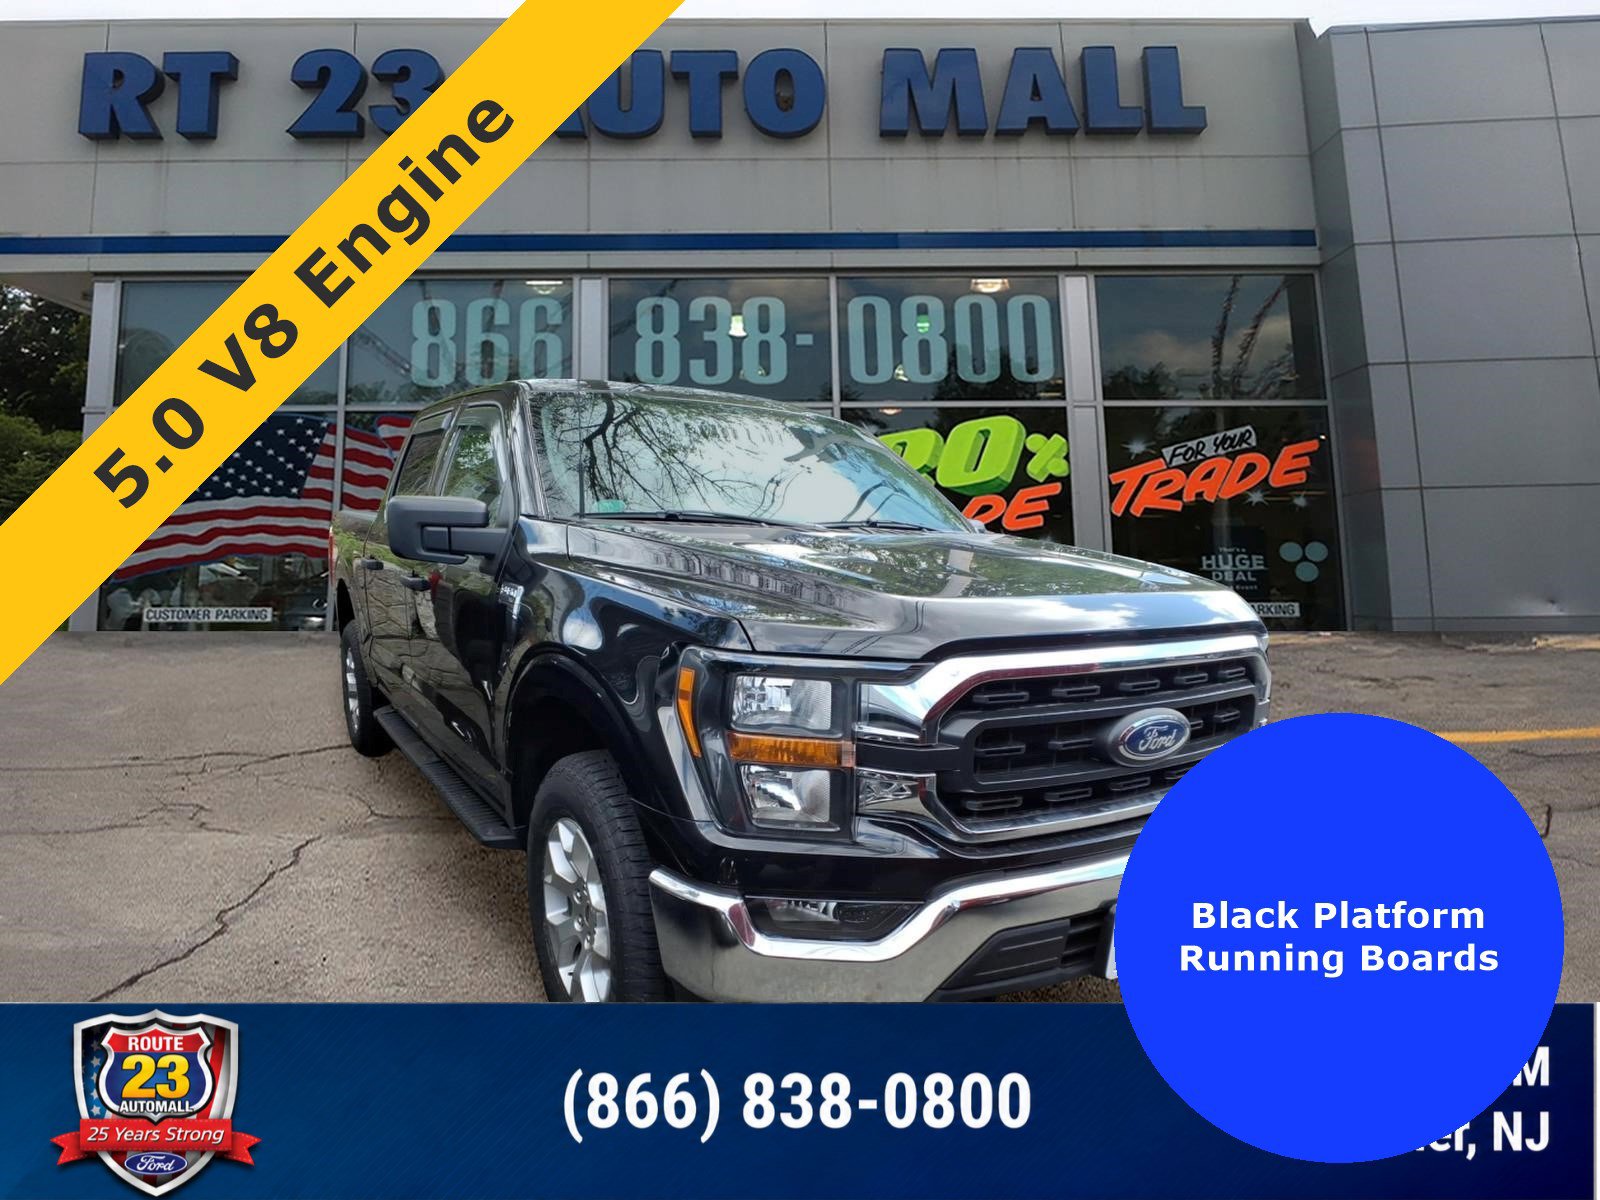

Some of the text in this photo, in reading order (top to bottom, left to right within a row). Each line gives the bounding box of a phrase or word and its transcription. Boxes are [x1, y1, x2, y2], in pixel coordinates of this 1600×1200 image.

[78, 46, 1208, 140] RT 23 UTO MALL
[410, 297, 565, 388] 866
[847, 295, 1055, 384] 0800
[1168, 428, 1253, 465] FOR YOUR
[1109, 438, 1321, 518] TRADE
[1201, 553, 1265, 570] HUGE
[1212, 571, 1257, 582] DEAL
[145, 608, 268, 621] CUSTOMER PARKING
[1251, 603, 1296, 615] ARKING
[1138, 724, 1178, 752] Ford
